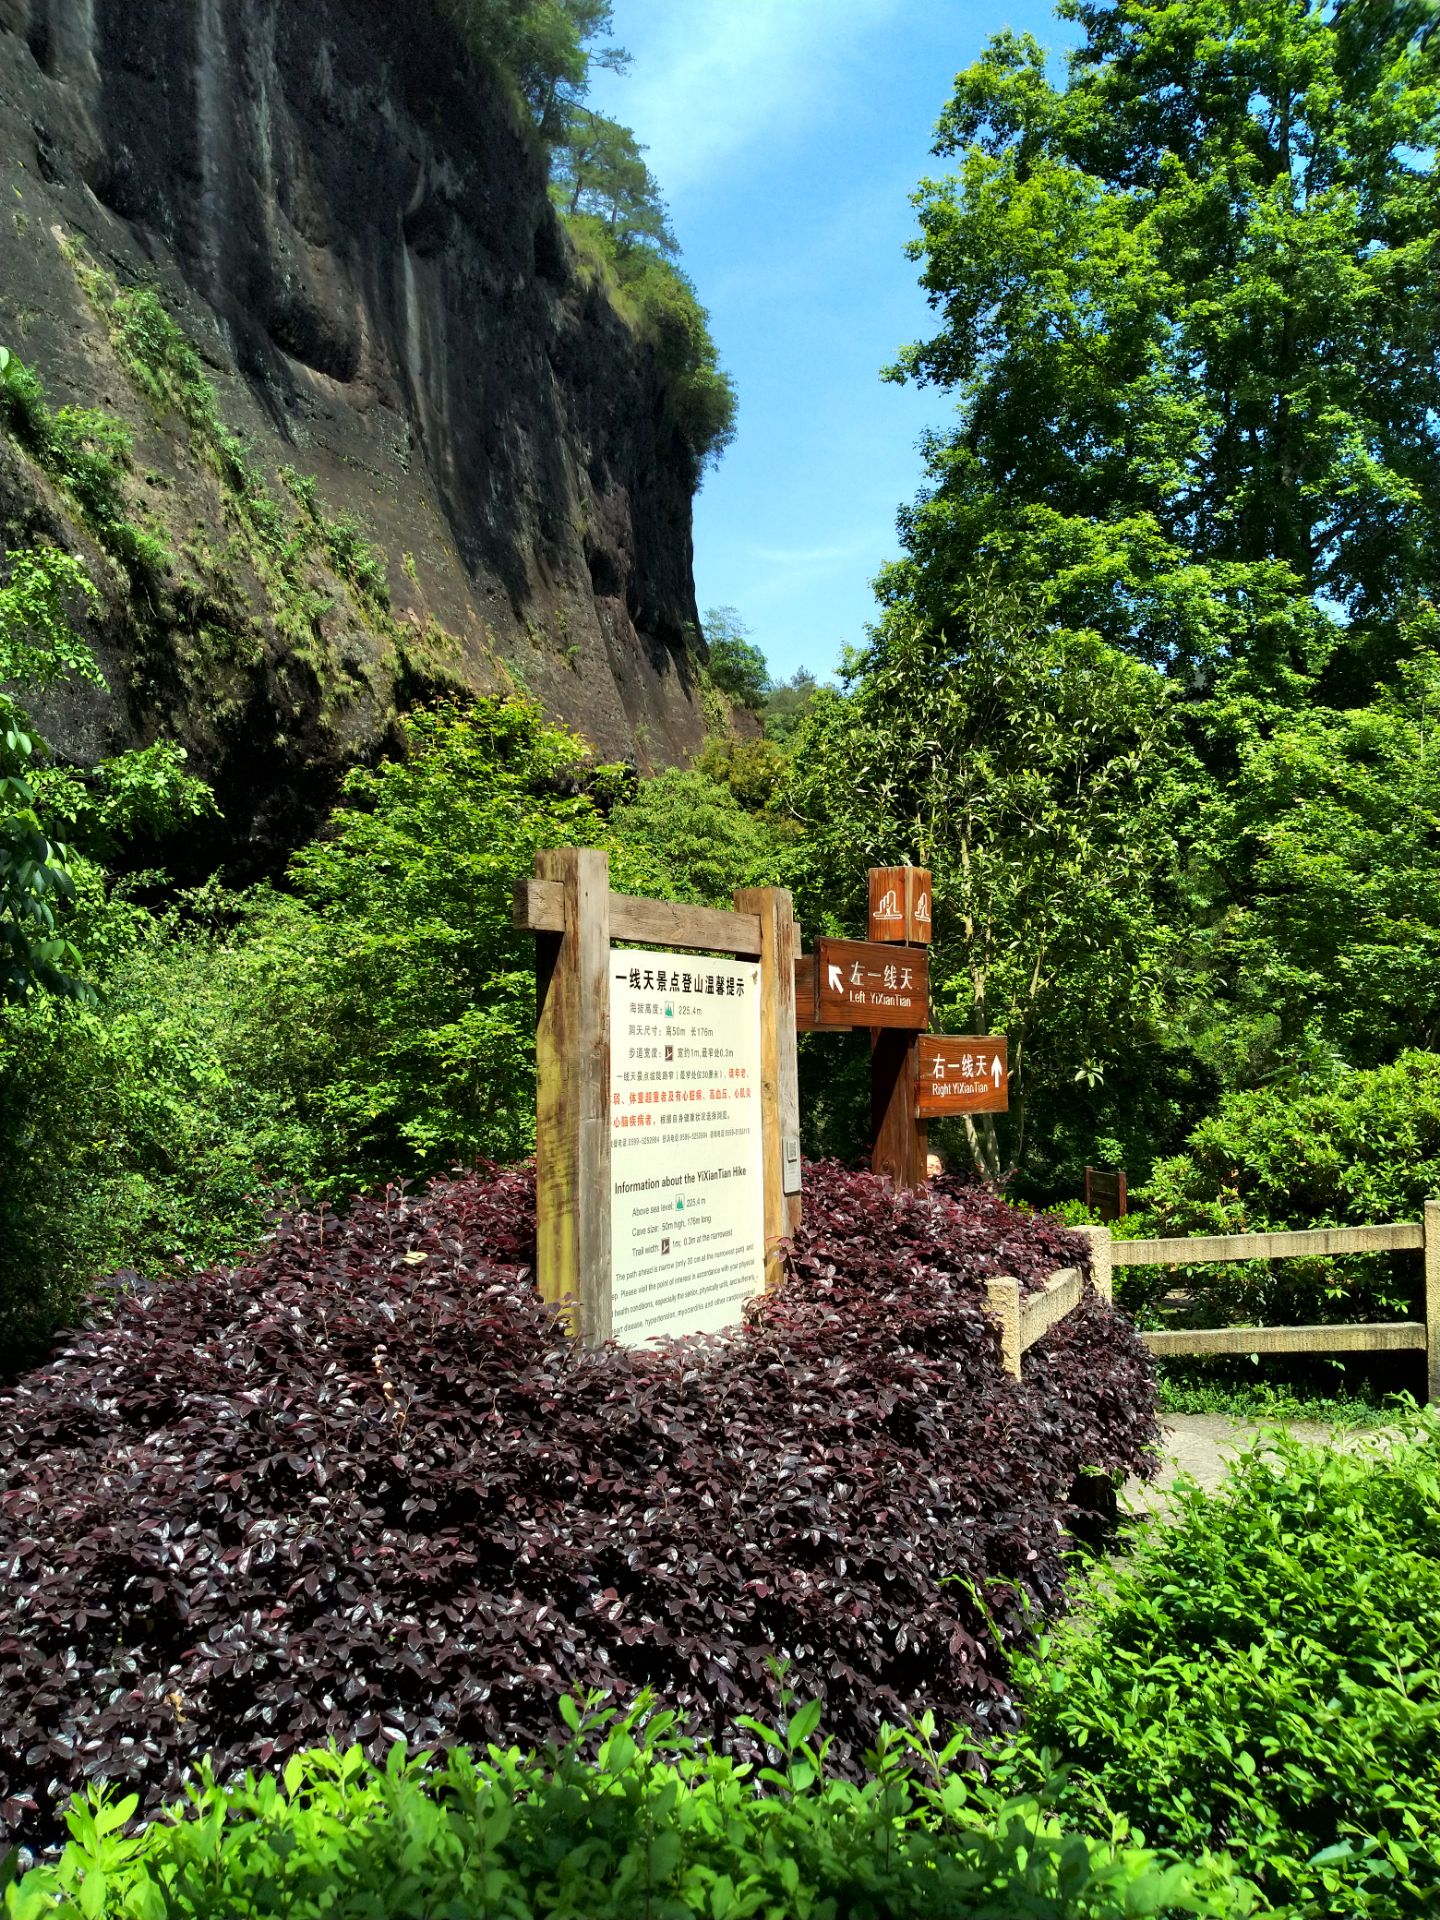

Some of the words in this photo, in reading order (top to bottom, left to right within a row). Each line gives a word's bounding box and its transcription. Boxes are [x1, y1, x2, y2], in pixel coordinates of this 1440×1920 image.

[615, 968, 744, 997] 一线天景点登山温馨提示
[850, 961, 913, 990] 左一线天
[849, 990, 866, 1004] Left
[870, 992, 912, 1008] YiXianTian
[932, 1053, 988, 1080] 右一线天
[932, 1083, 952, 1098] Right
[952, 1082, 988, 1096] YiXianTian
[615, 1178, 660, 1194] Information
[661, 1176, 683, 1188] about
[684, 1174, 696, 1184] the
[697, 1168, 731, 1182] YiXianTian
[732, 1166, 747, 1177] Hike
[632, 1207, 650, 1217] Above
[650, 1204, 660, 1213] sea
[632, 1227, 647, 1237] Cave
[647, 1225, 660, 1234] size:
[662, 1222, 673, 1232] 50m
[701, 1215, 712, 1225] long
[632, 1247, 644, 1257] Trail
[710, 1229, 733, 1241] narrowest
[615, 1273, 626, 1282] The
[626, 1270, 638, 1281] path
[659, 1262, 675, 1273] narrow
[620, 1288, 638, 1298] Please
[648, 1282, 656, 1291] the
[657, 1280, 669, 1290] point
[614, 1306, 629, 1317] health
[612, 1326, 624, 1336] eart
